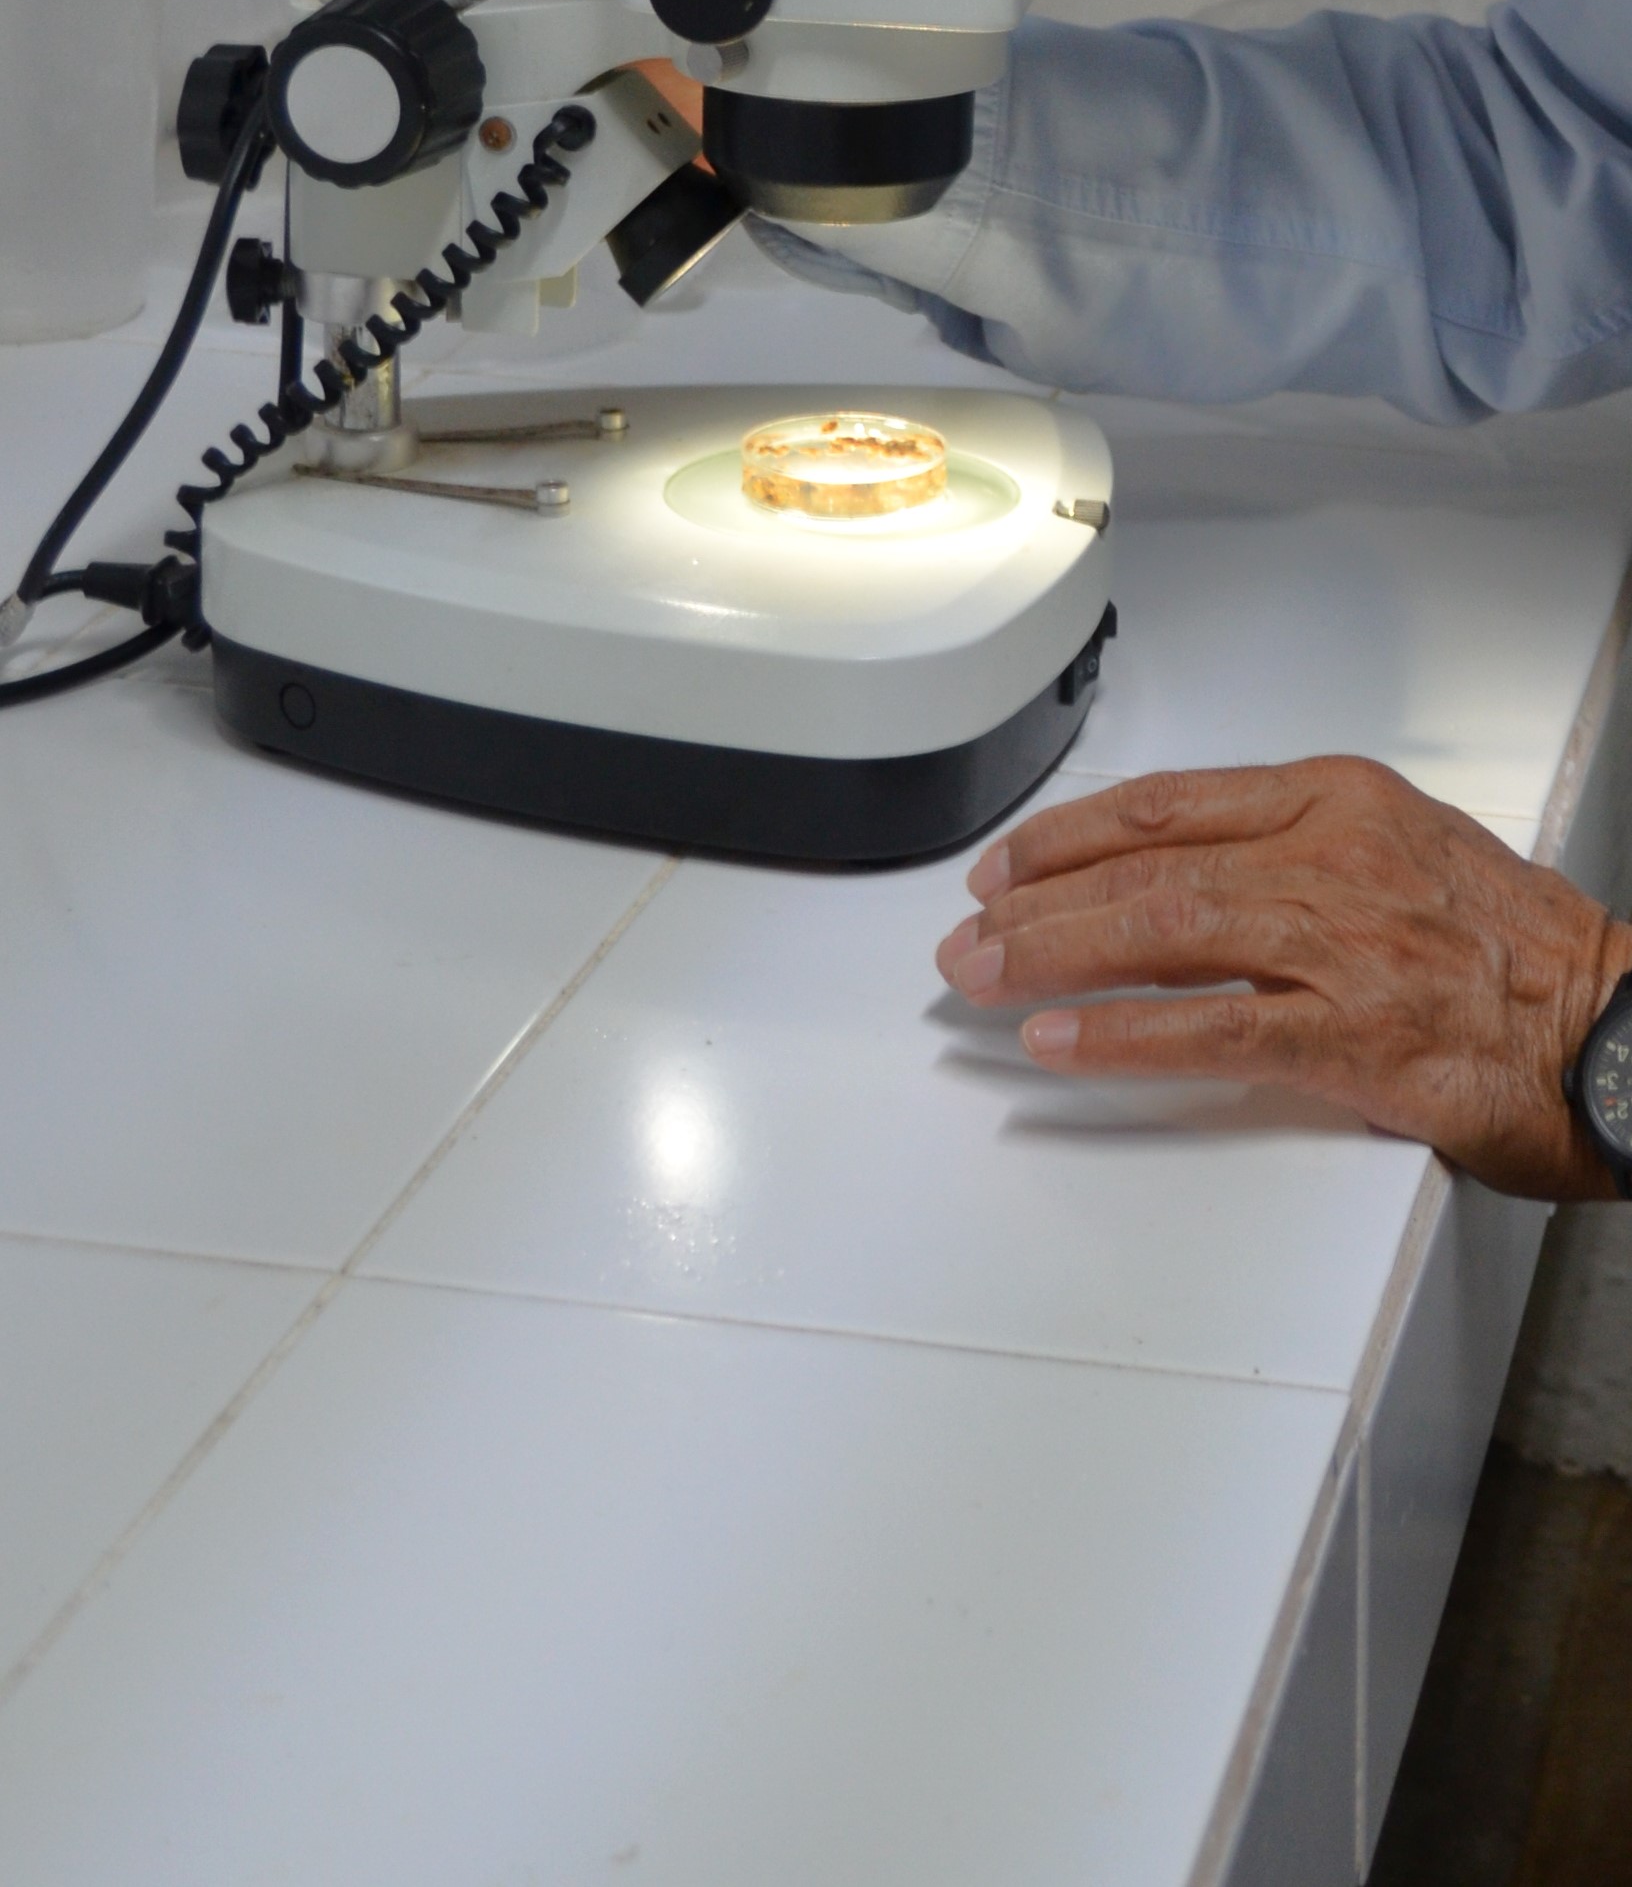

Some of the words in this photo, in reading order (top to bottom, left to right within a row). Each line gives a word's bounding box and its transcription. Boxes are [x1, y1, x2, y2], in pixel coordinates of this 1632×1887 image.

[1617, 1044, 1629, 1062] 4
[1607, 1070, 1619, 1090] 3
[1617, 1102, 1628, 1120] 2
